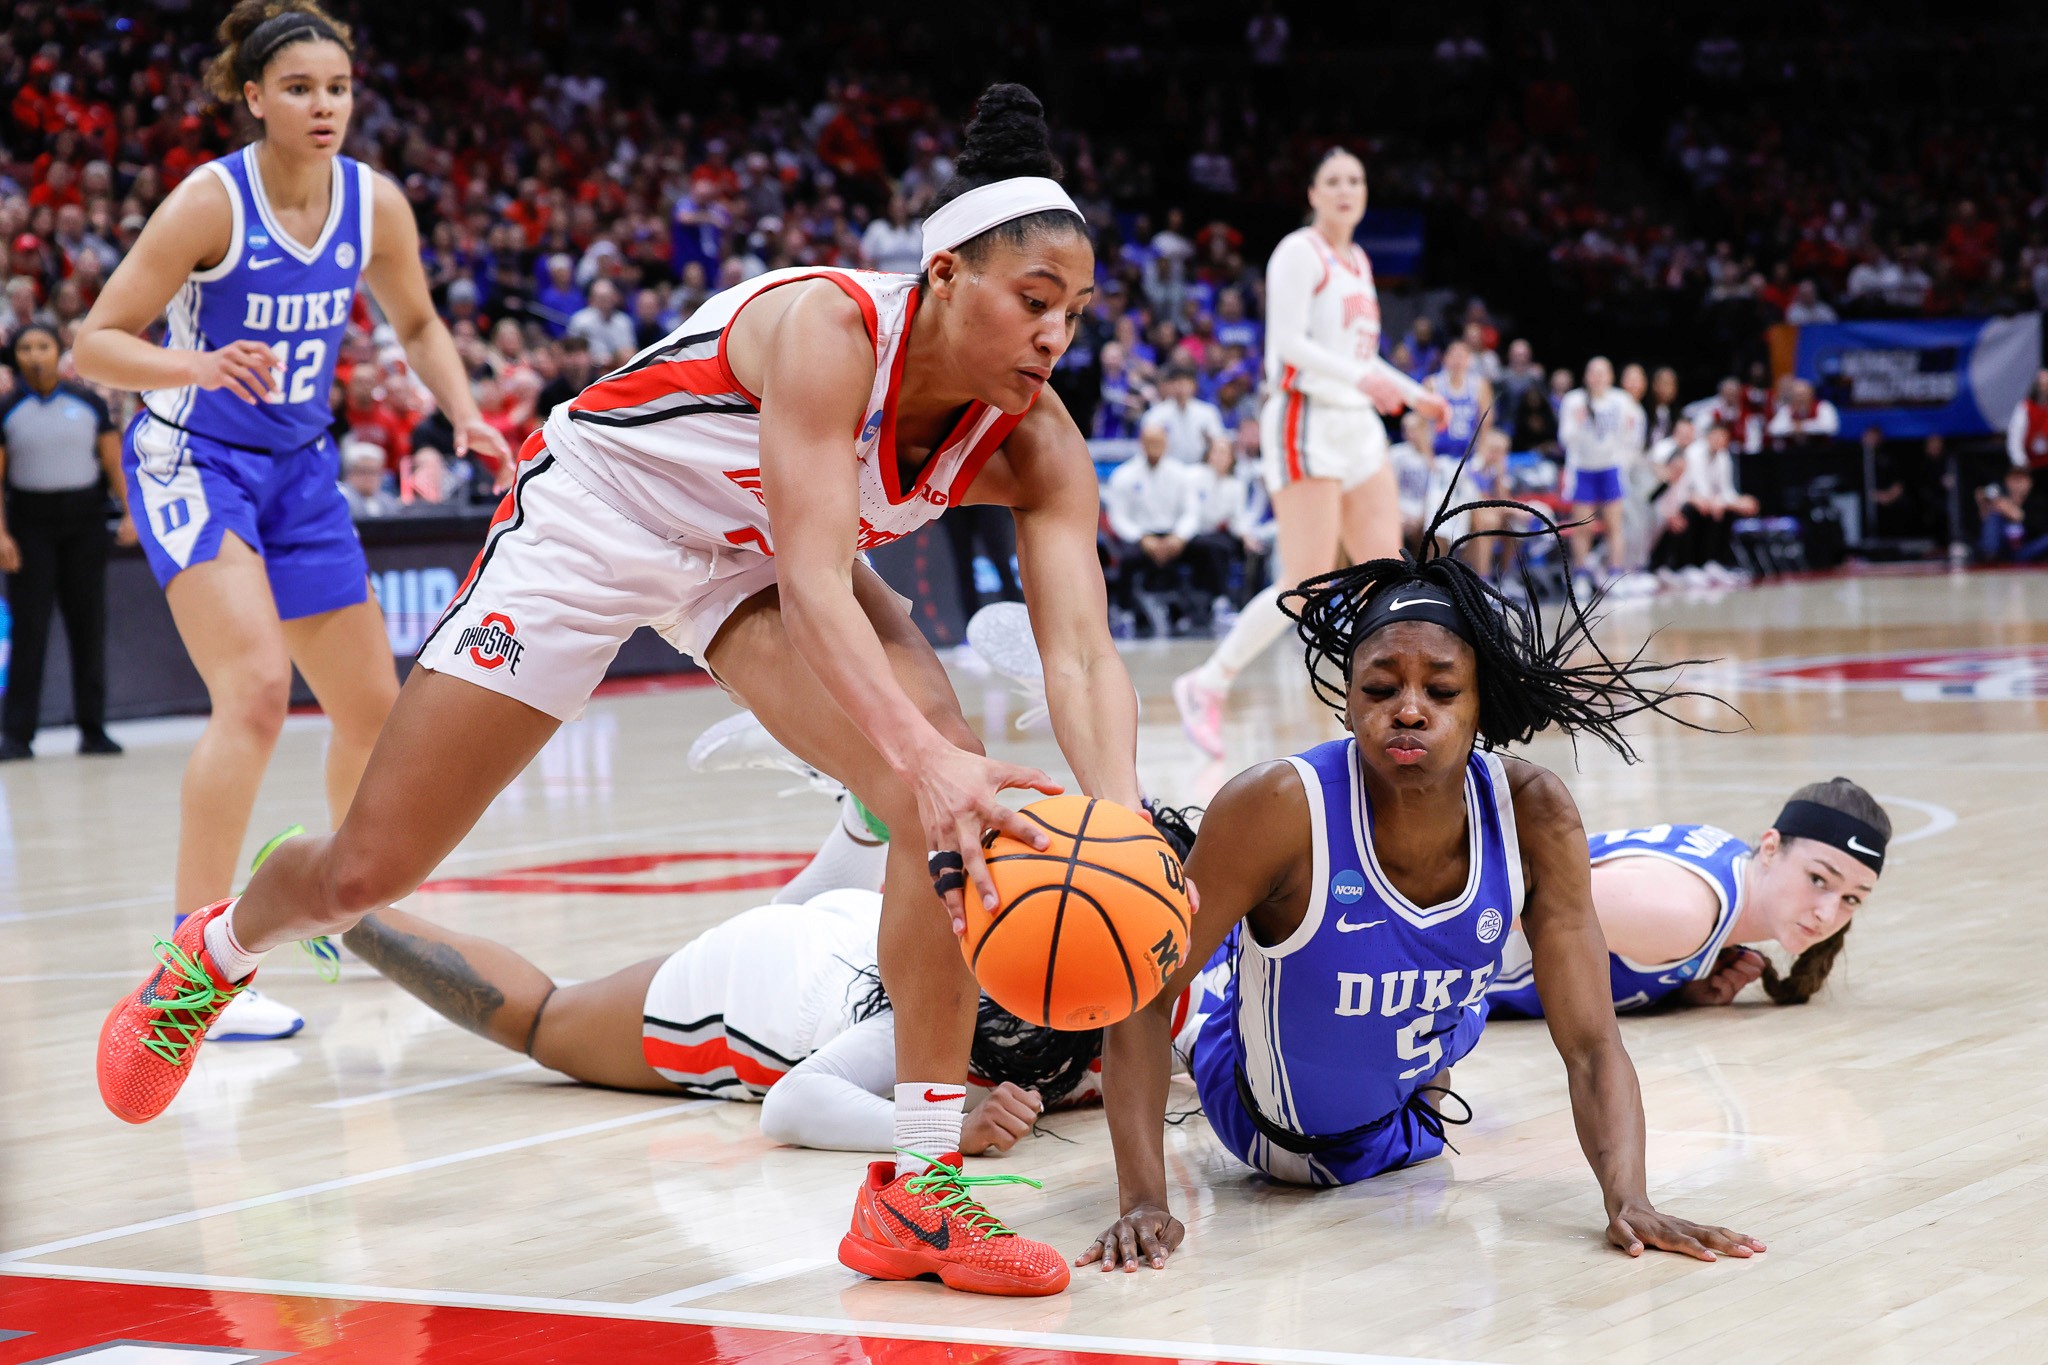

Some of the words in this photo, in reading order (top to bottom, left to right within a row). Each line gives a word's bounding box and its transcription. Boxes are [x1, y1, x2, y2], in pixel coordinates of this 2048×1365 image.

[243, 287, 351, 333] DUKE
[158, 497, 190, 535] D
[1335, 885, 1363, 896] NCAA
[1480, 917, 1499, 930] ACC
[1334, 960, 1495, 1017] DUKE
[1396, 1013, 1443, 1080] 5
